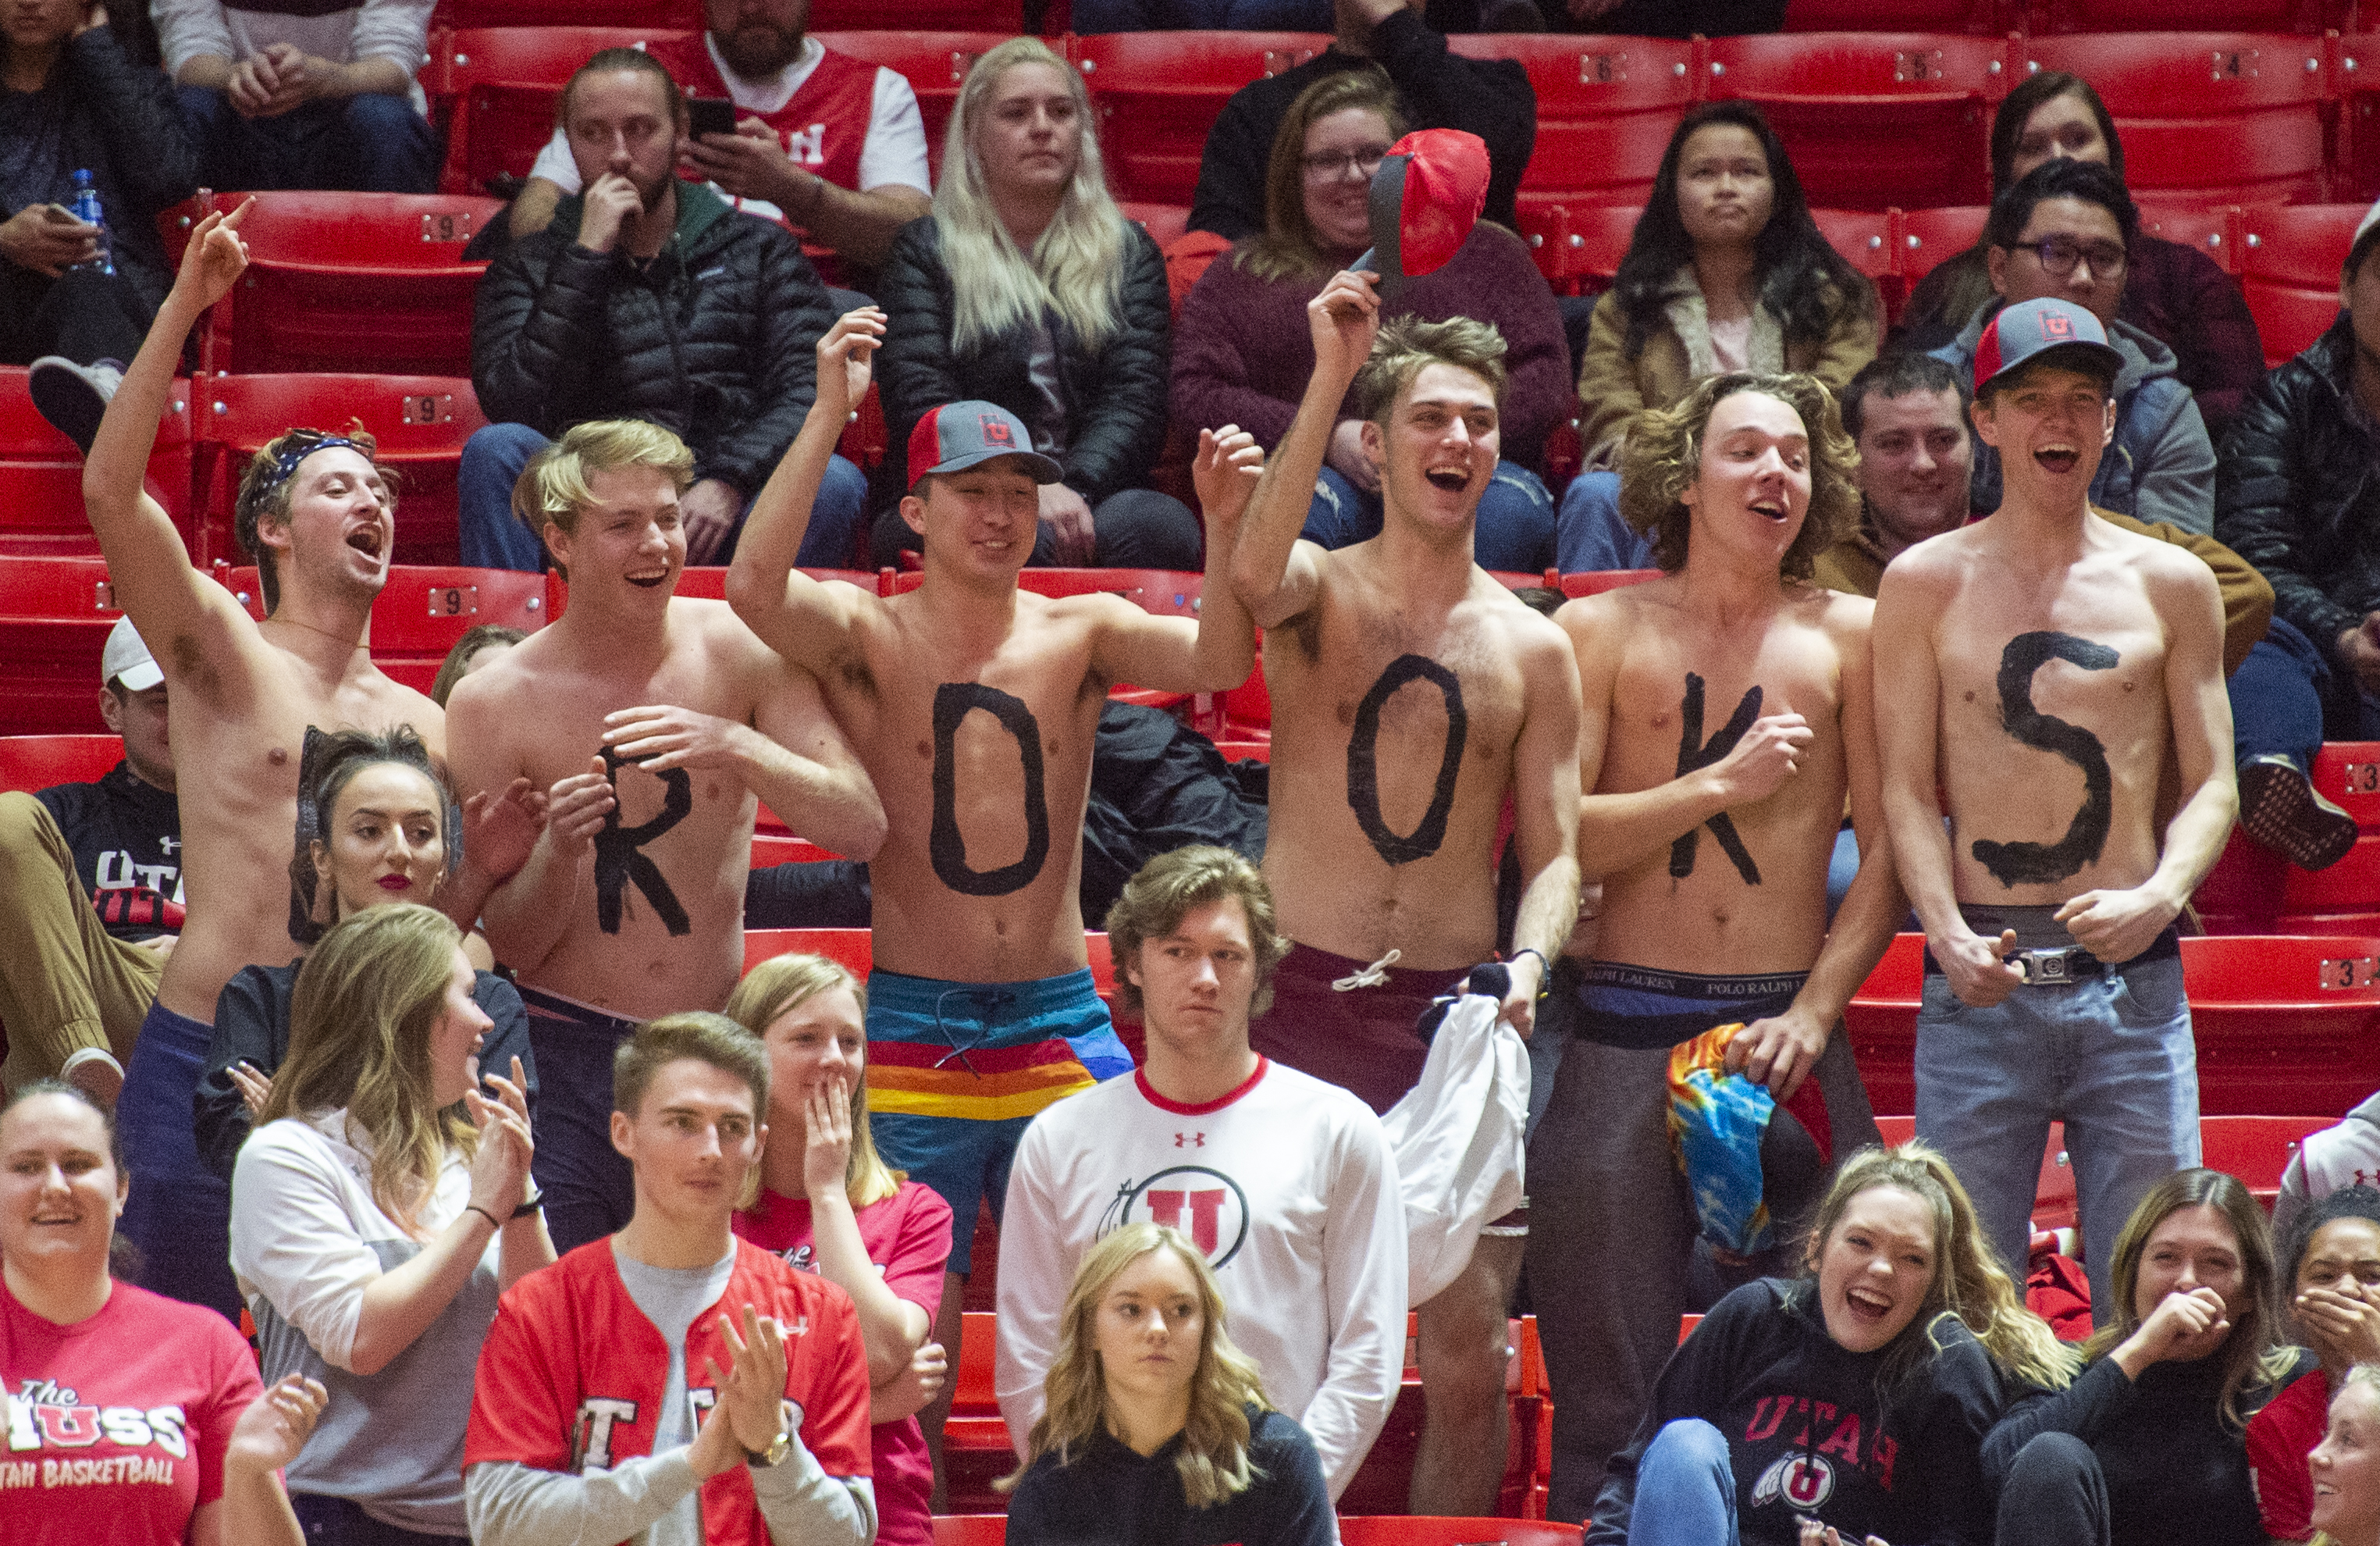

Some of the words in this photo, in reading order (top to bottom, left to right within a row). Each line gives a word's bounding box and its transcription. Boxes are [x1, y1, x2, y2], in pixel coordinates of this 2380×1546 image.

[2226, 54, 2239, 77] 4
[439, 215, 453, 241] 9
[2046, 319, 2068, 334] U
[421, 397, 435, 422] 9
[987, 422, 1009, 440] U
[446, 590, 461, 614] 9
[594, 744, 692, 937] R
[1347, 653, 1467, 867] O
[1669, 671, 1763, 885] K
[1972, 631, 2120, 889] S
[2364, 764, 2377, 791] 3
[2339, 960, 2353, 987] 3
[1707, 982, 1745, 994] POLO
[19, 1377, 80, 1405] The
[1745, 1395, 1899, 1493] UTAH
[43, 1454, 173, 1489] BASKETBALL
[1789, 1462, 1827, 1503] U
